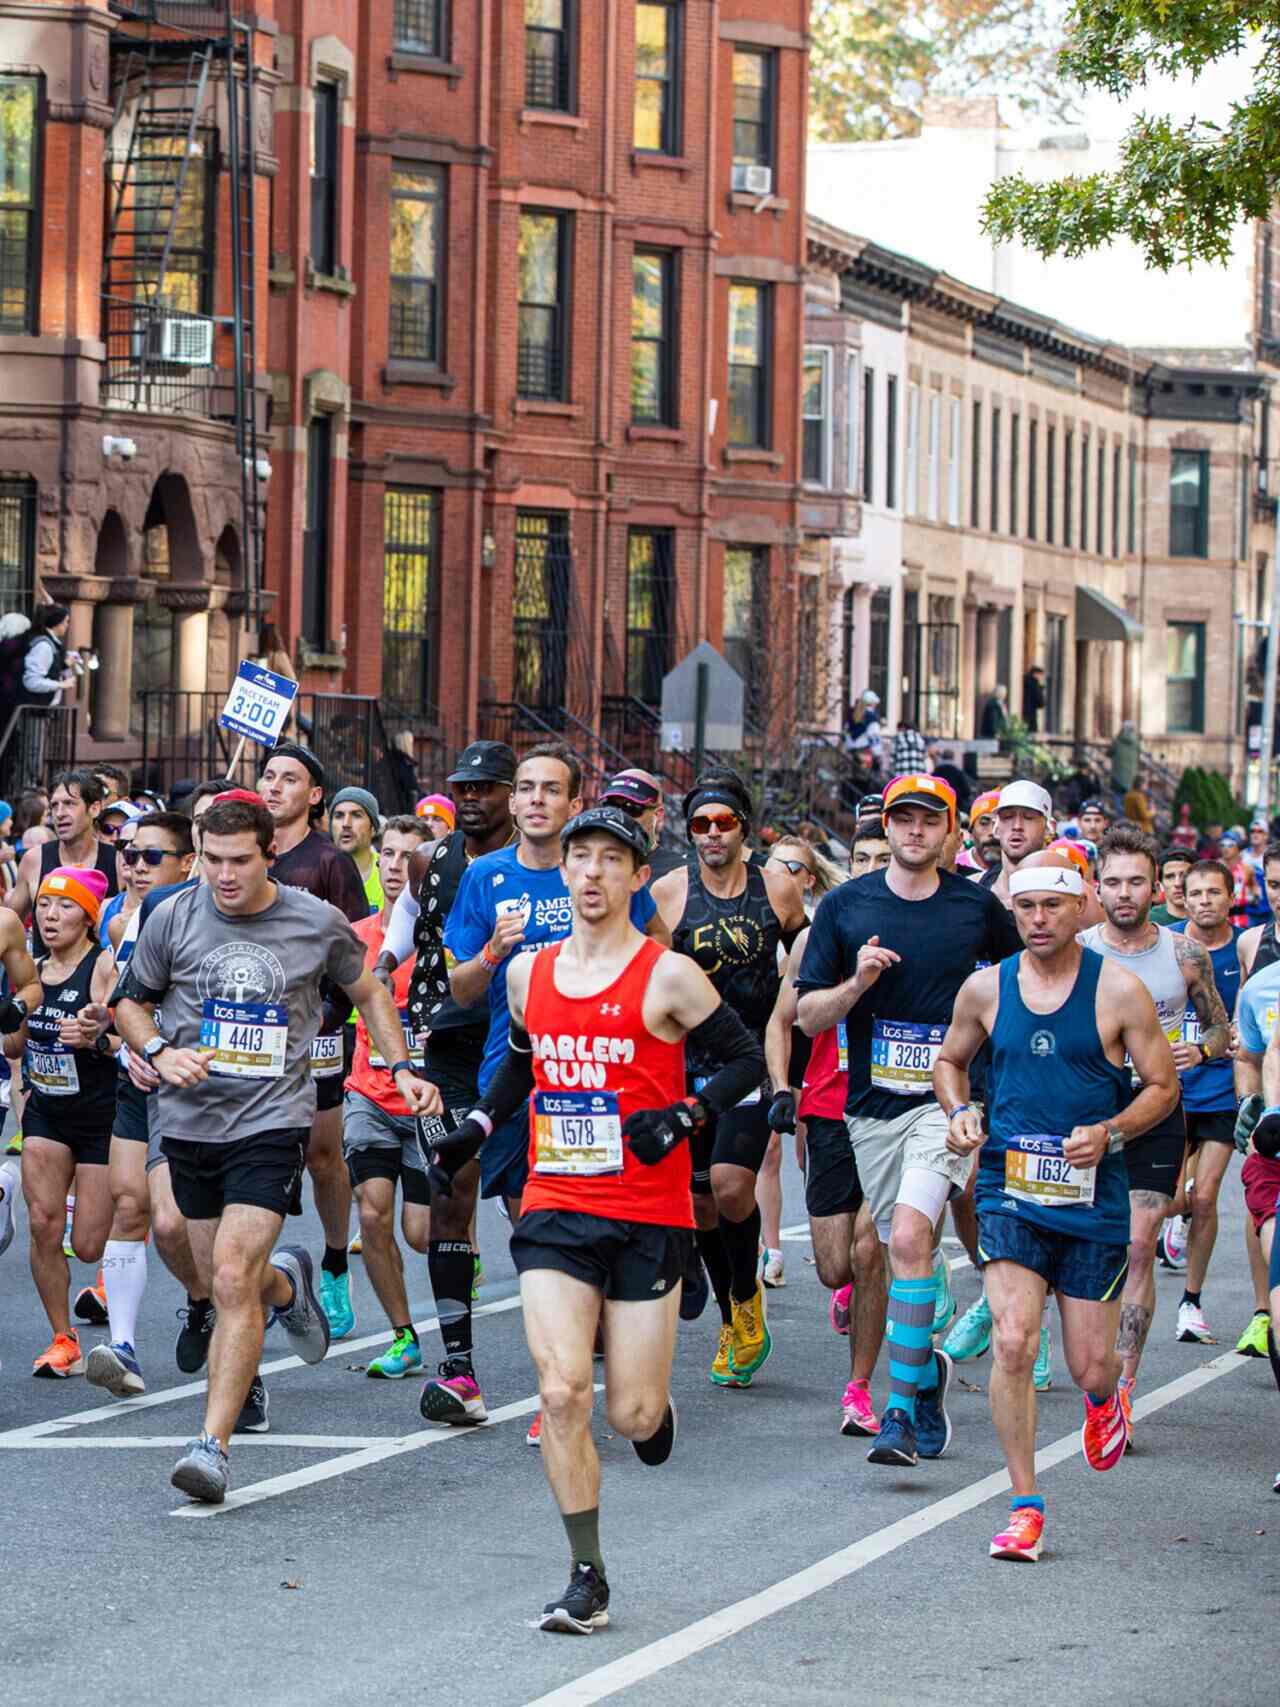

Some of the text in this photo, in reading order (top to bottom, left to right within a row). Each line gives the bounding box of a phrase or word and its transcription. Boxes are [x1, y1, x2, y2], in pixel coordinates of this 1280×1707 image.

[232, 694, 276, 729] 3:00
[214, 1003, 234, 1020] tcs
[44, 1022, 62, 1031] CLU
[228, 1026, 264, 1052] 4413
[883, 1024, 902, 1039] tcs
[529, 1033, 635, 1065] HARLEM
[896, 1044, 931, 1069] 3283
[543, 1060, 607, 1089] RUN
[543, 1096, 562, 1113] tcs
[561, 1119, 595, 1146] 1578
[1020, 1137, 1041, 1152] tcs
[1037, 1158, 1071, 1183] 1632
